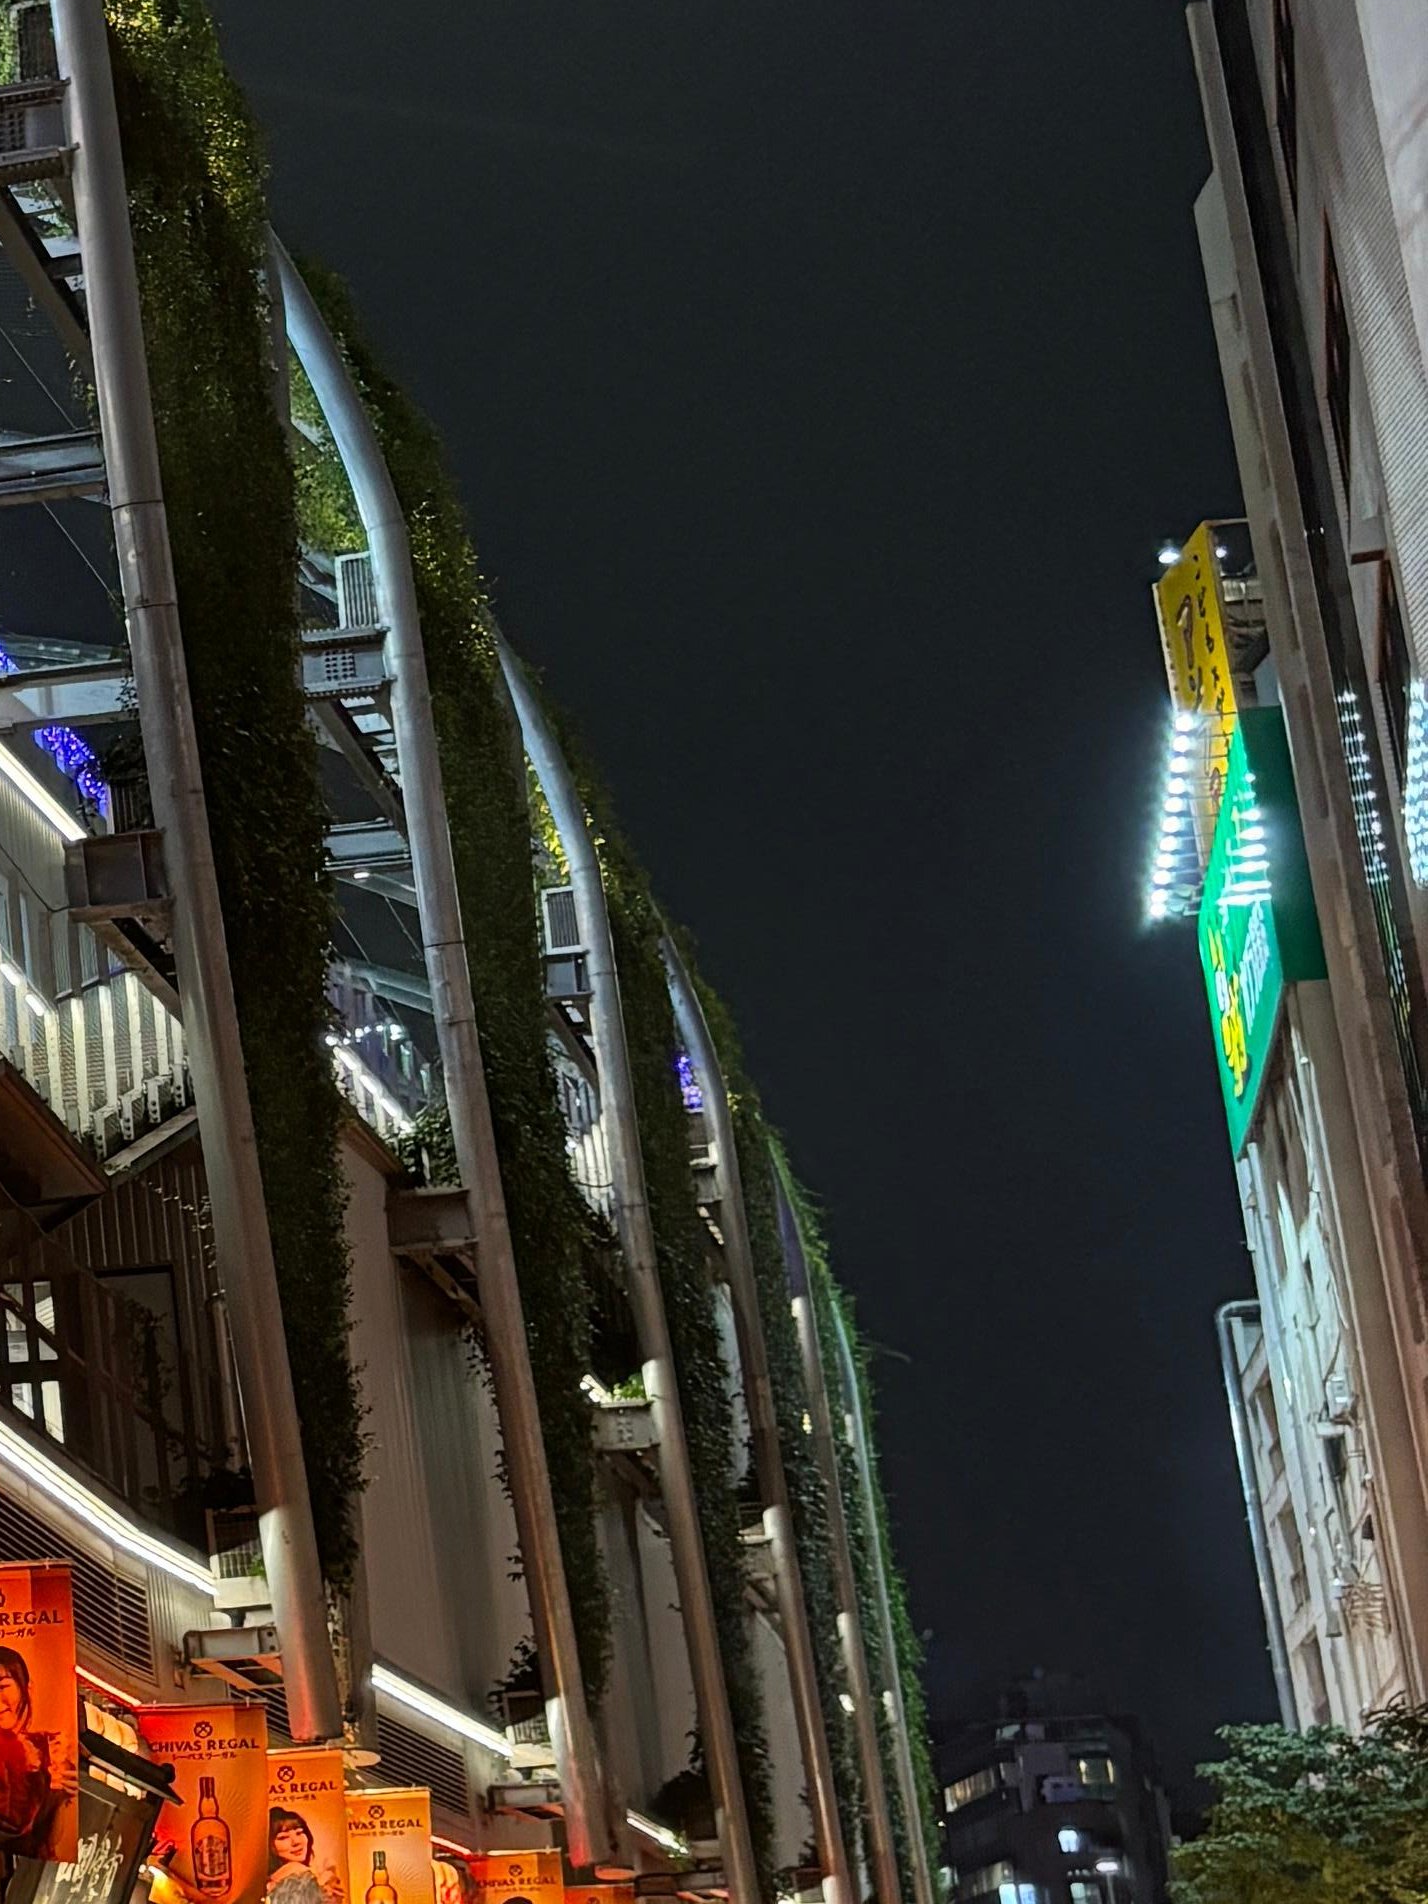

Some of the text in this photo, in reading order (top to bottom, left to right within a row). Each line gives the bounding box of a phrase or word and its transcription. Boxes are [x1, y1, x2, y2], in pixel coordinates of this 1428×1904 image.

[151, 1736, 260, 1754] CHIVAS REGAL
[290, 1780, 338, 1794] REGAL
[348, 1818, 424, 1831] IVAS REGAL
